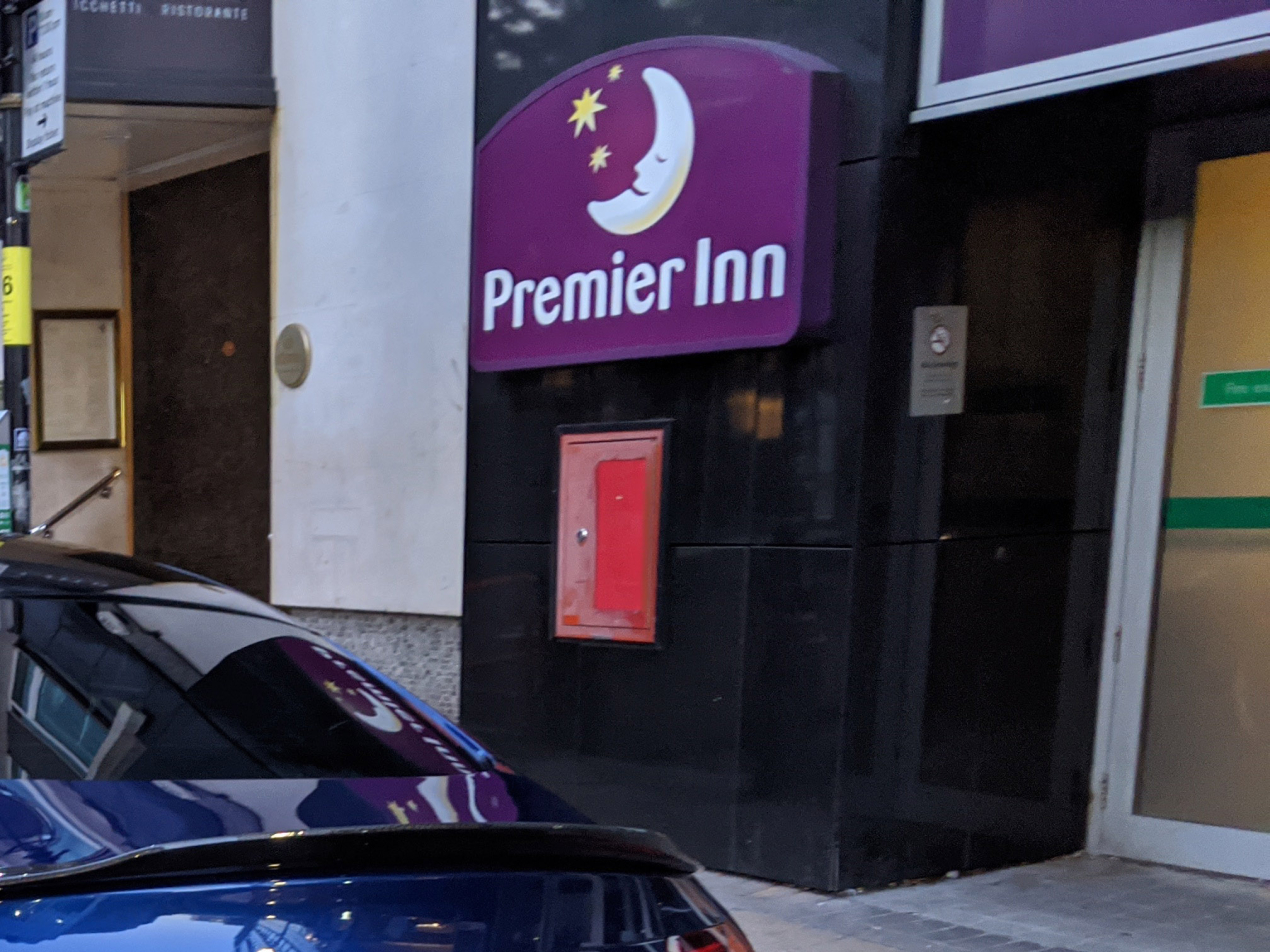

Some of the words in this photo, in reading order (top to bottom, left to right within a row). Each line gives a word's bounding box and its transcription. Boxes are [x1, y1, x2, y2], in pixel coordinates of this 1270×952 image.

[70, 0, 142, 14] ICCHETTI
[161, 3, 248, 21] RISTORANTE
[483, 250, 686, 331] Premier
[693, 237, 786, 306] Inn
